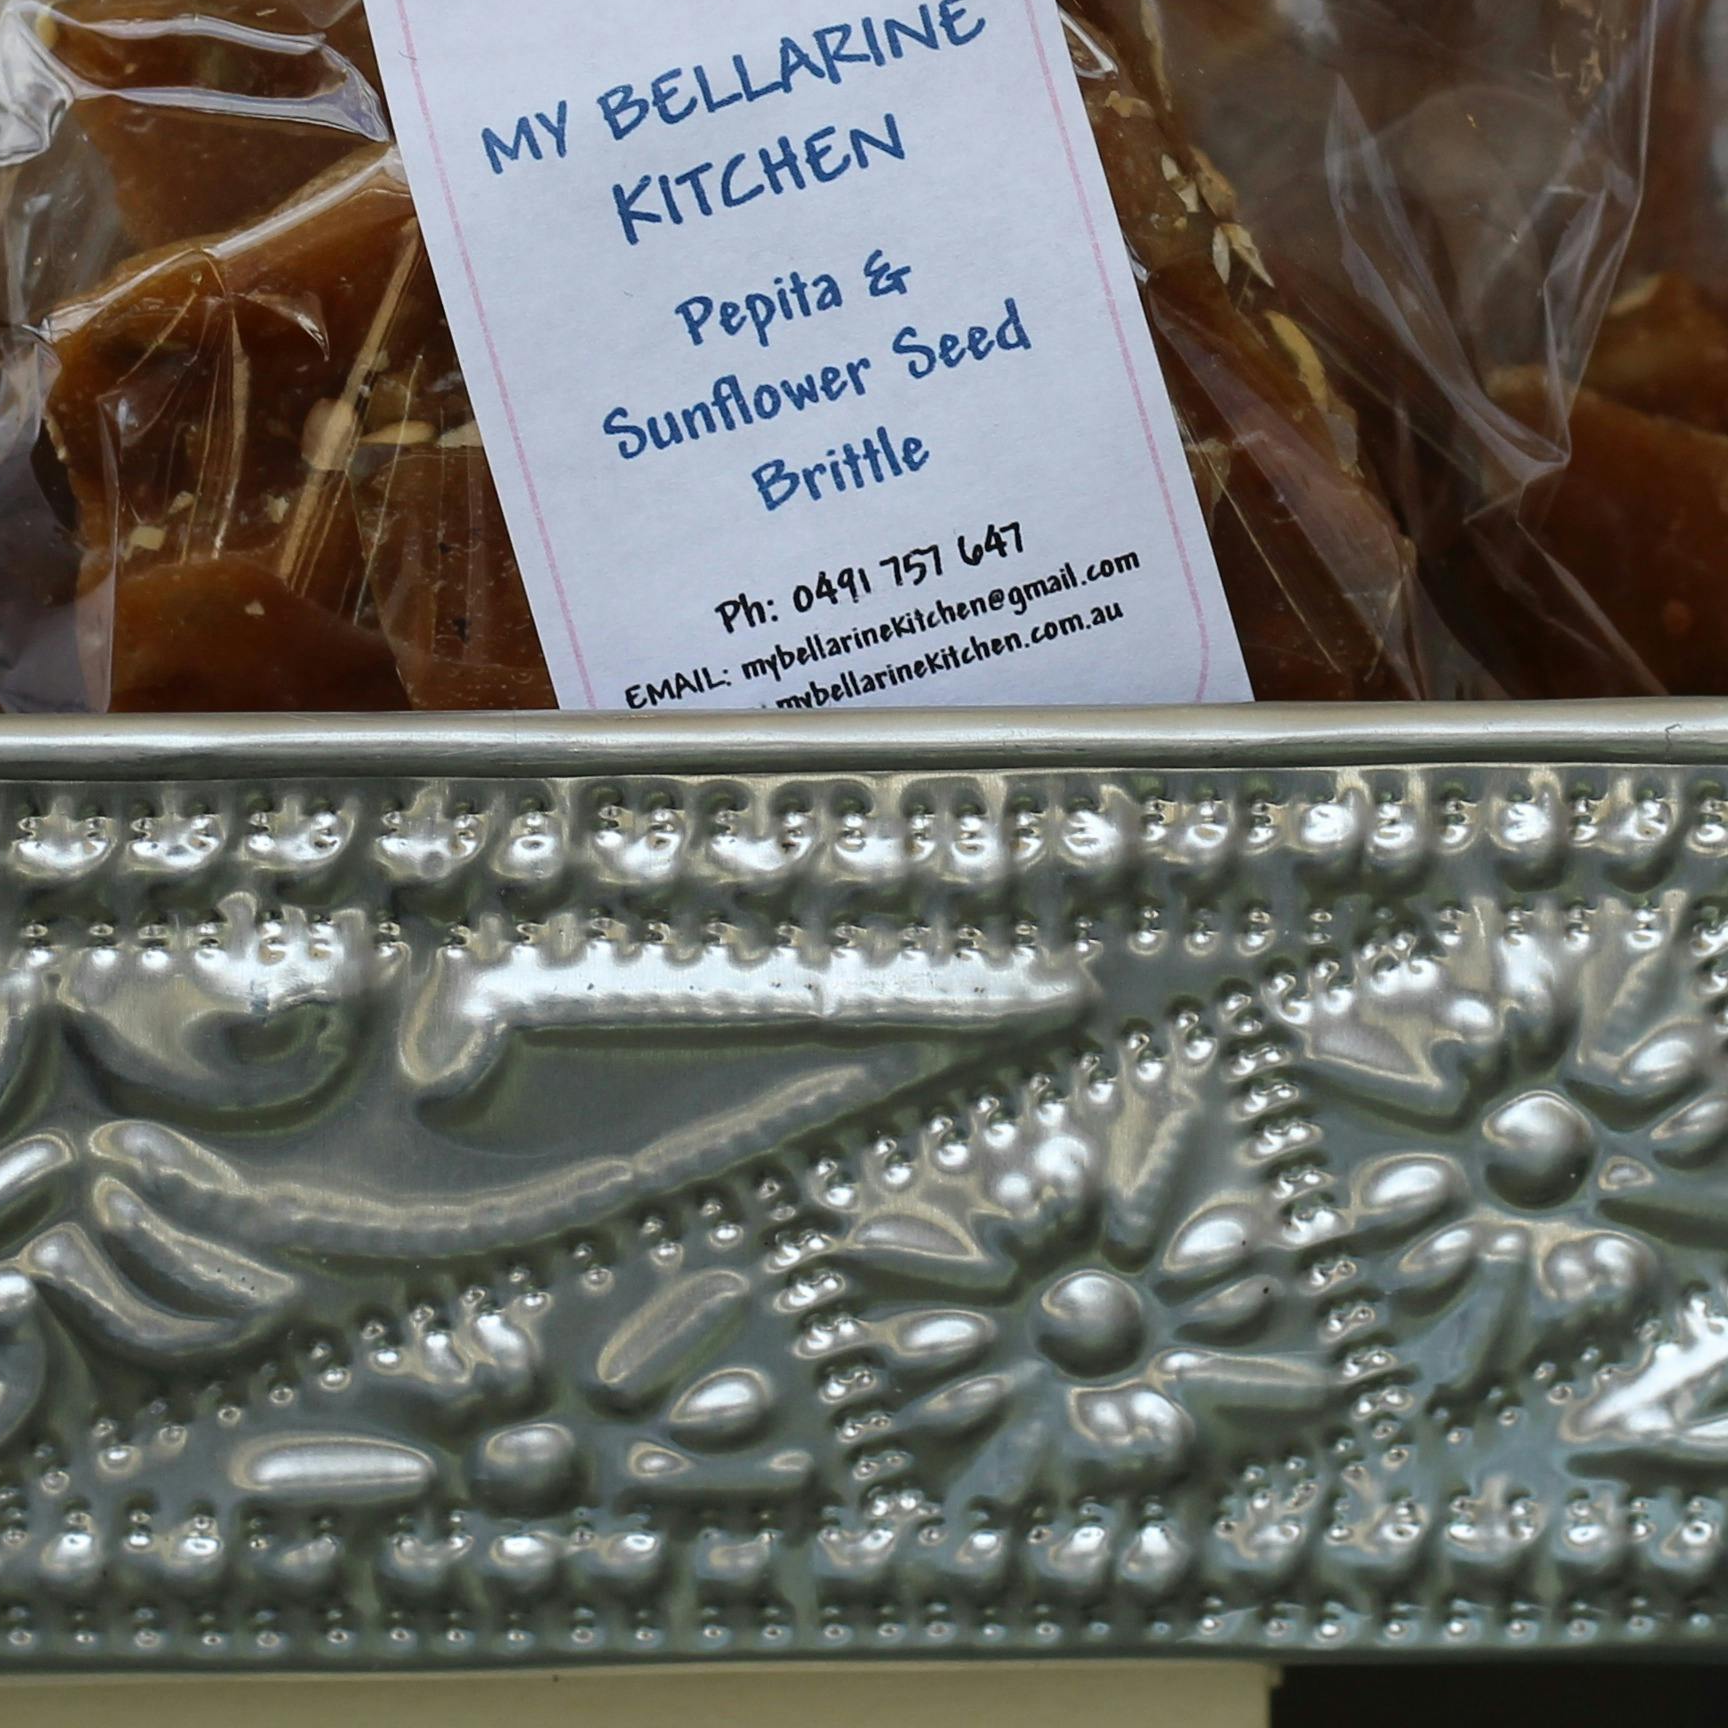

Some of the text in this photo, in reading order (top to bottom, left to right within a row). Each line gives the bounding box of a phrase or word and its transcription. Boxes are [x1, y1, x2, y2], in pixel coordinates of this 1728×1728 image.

[482, 100, 567, 174] MY
[612, 114, 905, 245] KITCHEN
[675, 250, 911, 345] Pepita &
[603, 298, 1031, 459] Sunflower Seed
[752, 427, 929, 511] Brittle
[715, 522, 1023, 634] Ph: 0491 757 647
[625, 667, 731, 709] EMAIL:
[776, 603, 1123, 709] mybellarinekitchen.com.au
